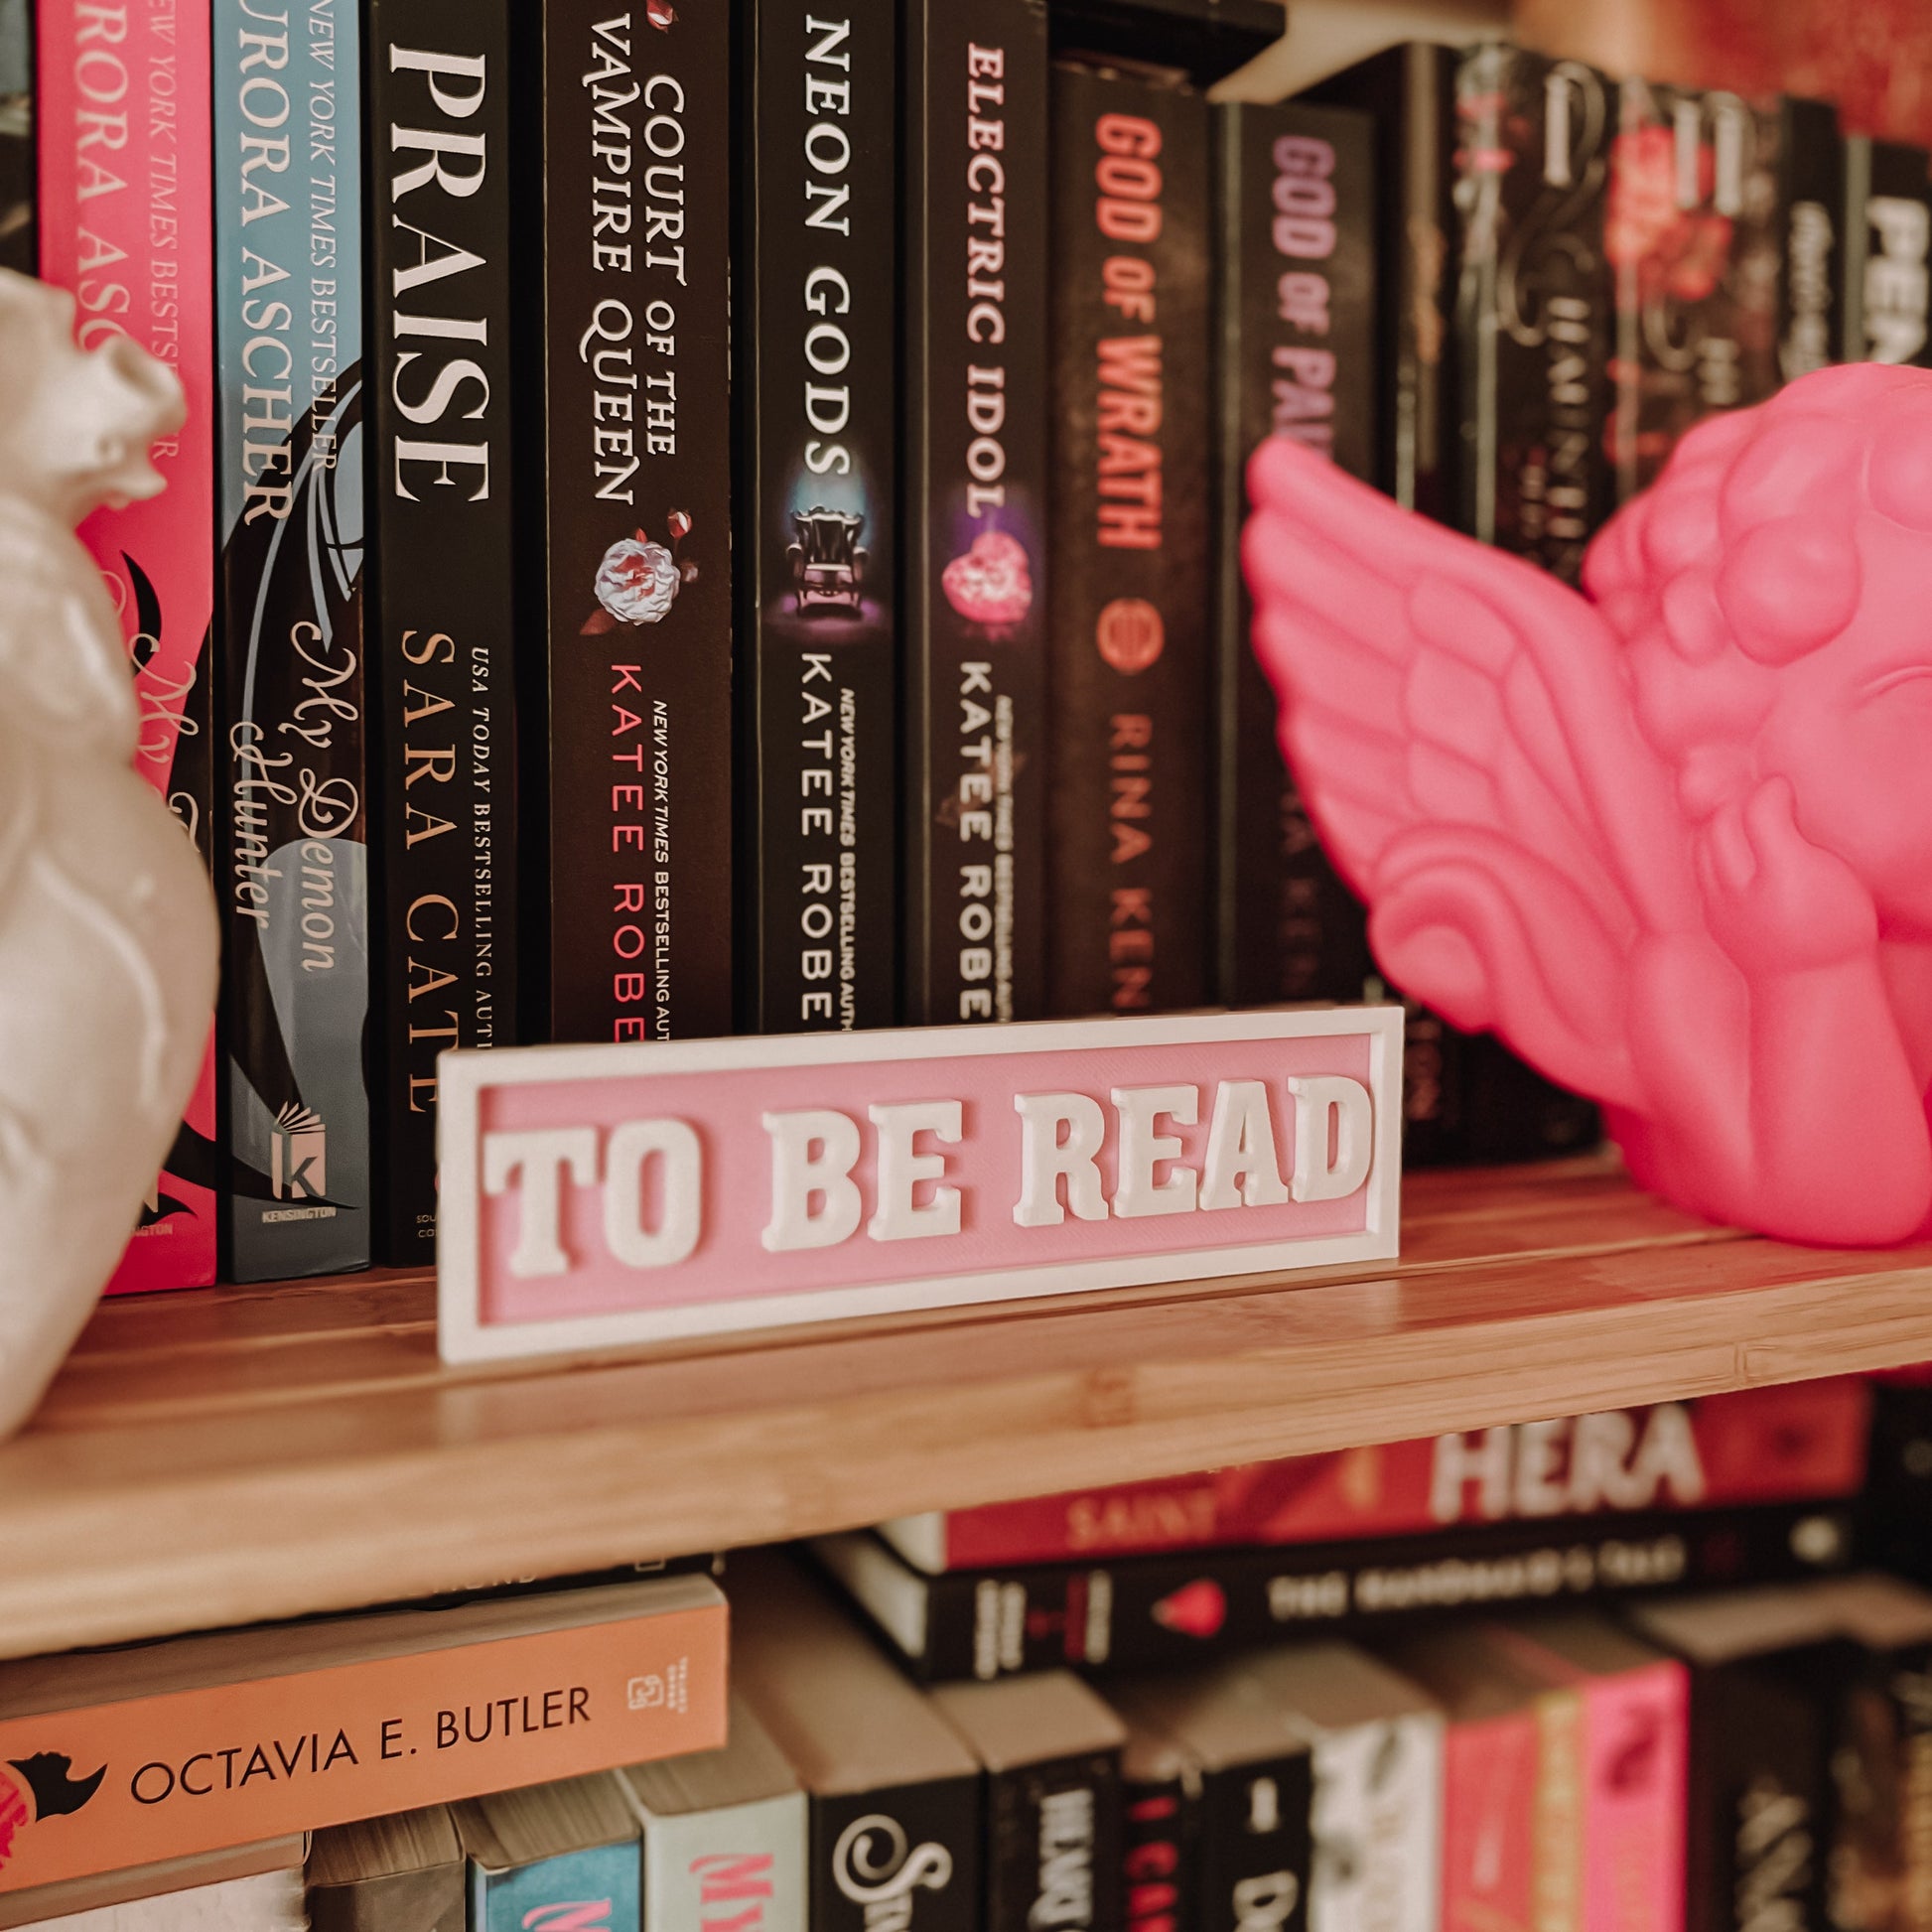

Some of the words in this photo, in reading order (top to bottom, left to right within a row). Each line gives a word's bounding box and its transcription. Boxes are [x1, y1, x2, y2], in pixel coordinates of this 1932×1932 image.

[149, 55, 177, 143] YORK
[308, 0, 335, 70] NEW
[309, 79, 336, 166] YORK
[582, 12, 640, 273] VAMPIRE
[643, 73, 687, 287] COURT
[804, 14, 851, 236] NEON
[1095, 112, 1163, 243] GOD
[150, 153, 178, 250] TIMES
[309, 175, 337, 268] TIMES
[967, 42, 1005, 345] ELECTRIC
[1272, 134, 1336, 260] GOD
[389, 43, 489, 504] PRAISE
[645, 300, 675, 356] OF
[1102, 255, 1157, 324] OF
[1277, 271, 1330, 335] OF
[241, 247, 293, 525] ASCHER
[310, 278, 338, 473] BESTSELLER
[580, 299, 640, 505] QUEEN
[646, 370, 676, 456] THE
[804, 265, 851, 476] GODS
[967, 363, 1006, 518] IDOL
[1097, 334, 1163, 550] WRATH
[278, 621, 359, 749] My
[472, 647, 489, 693] USA
[652, 700, 668, 747] NEW
[840, 688, 855, 735] NEW
[401, 630, 458, 851] SARA
[472, 707, 492, 793] TODAY
[611, 664, 644, 853] KATEE
[653, 750, 669, 801] YORK
[801, 652, 833, 836] KATEE
[840, 736, 856, 787] YORK
[959, 661, 992, 842] KATEE
[1110, 714, 1154, 864] RINA
[229, 721, 298, 931] Hunter
[298, 768, 359, 973] Demon
[653, 805, 669, 864] TIMES
[840, 789, 856, 846] TIMES
[473, 803, 492, 978] BESTSELLING
[654, 872, 670, 1003] BESTSELLING
[801, 864, 833, 1021] ROBE
[840, 852, 856, 980] BESTSELLING
[261, 1206, 338, 1224] KENSINGTON
[483, 1116, 704, 1279] TO
[761, 1099, 965, 1254] BE
[1013, 1073, 1376, 1228] READ
[1429, 1402, 1708, 1526] HERA
[130, 1728, 359, 1805] OCTAVIA
[380, 1719, 418, 1761] E.
[435, 1686, 593, 1751] BUTLER
